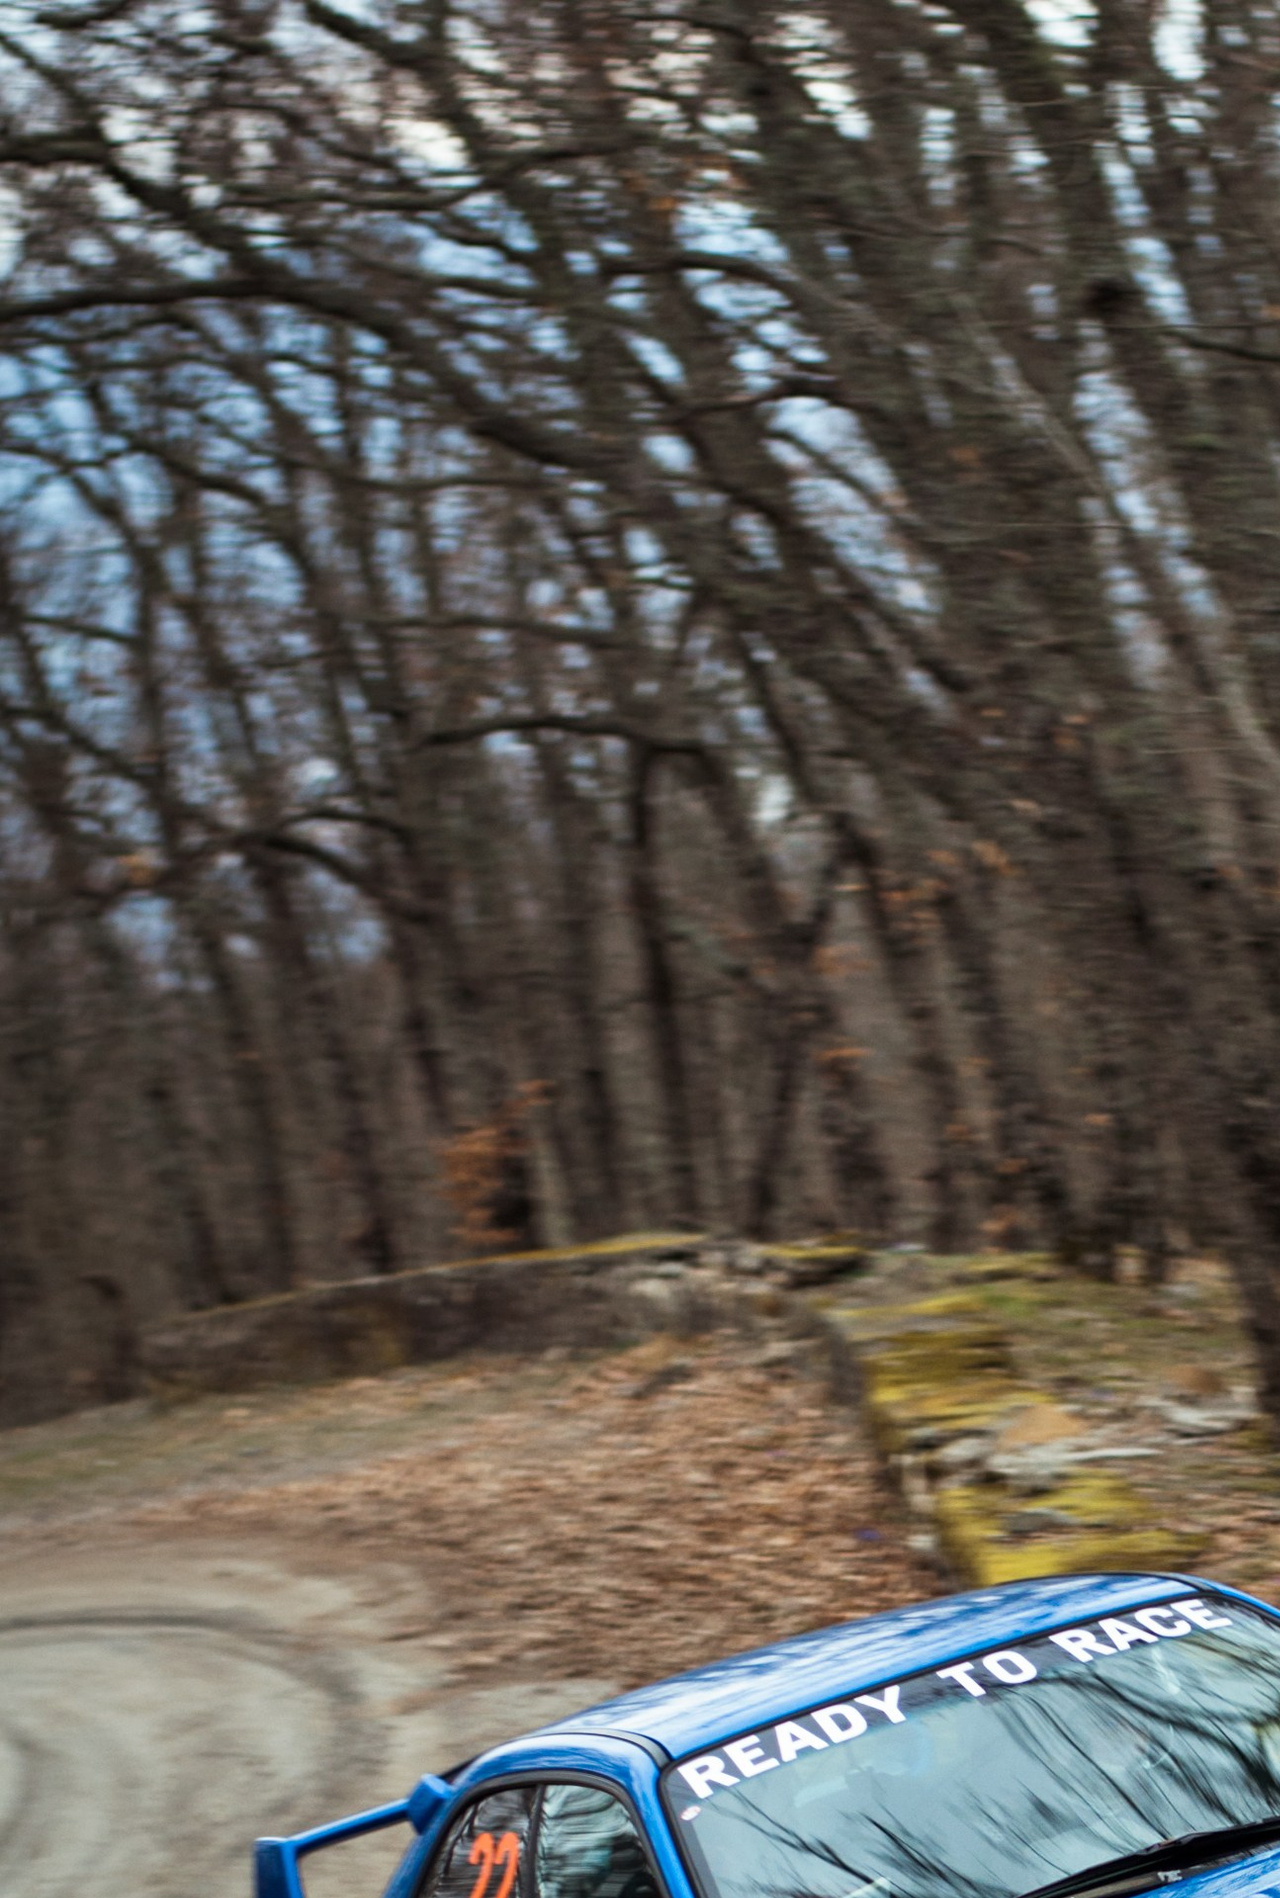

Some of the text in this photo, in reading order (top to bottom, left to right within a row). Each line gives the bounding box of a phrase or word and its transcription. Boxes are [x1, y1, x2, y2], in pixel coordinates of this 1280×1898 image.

[677, 1599, 1233, 1800] READY TO RACE
